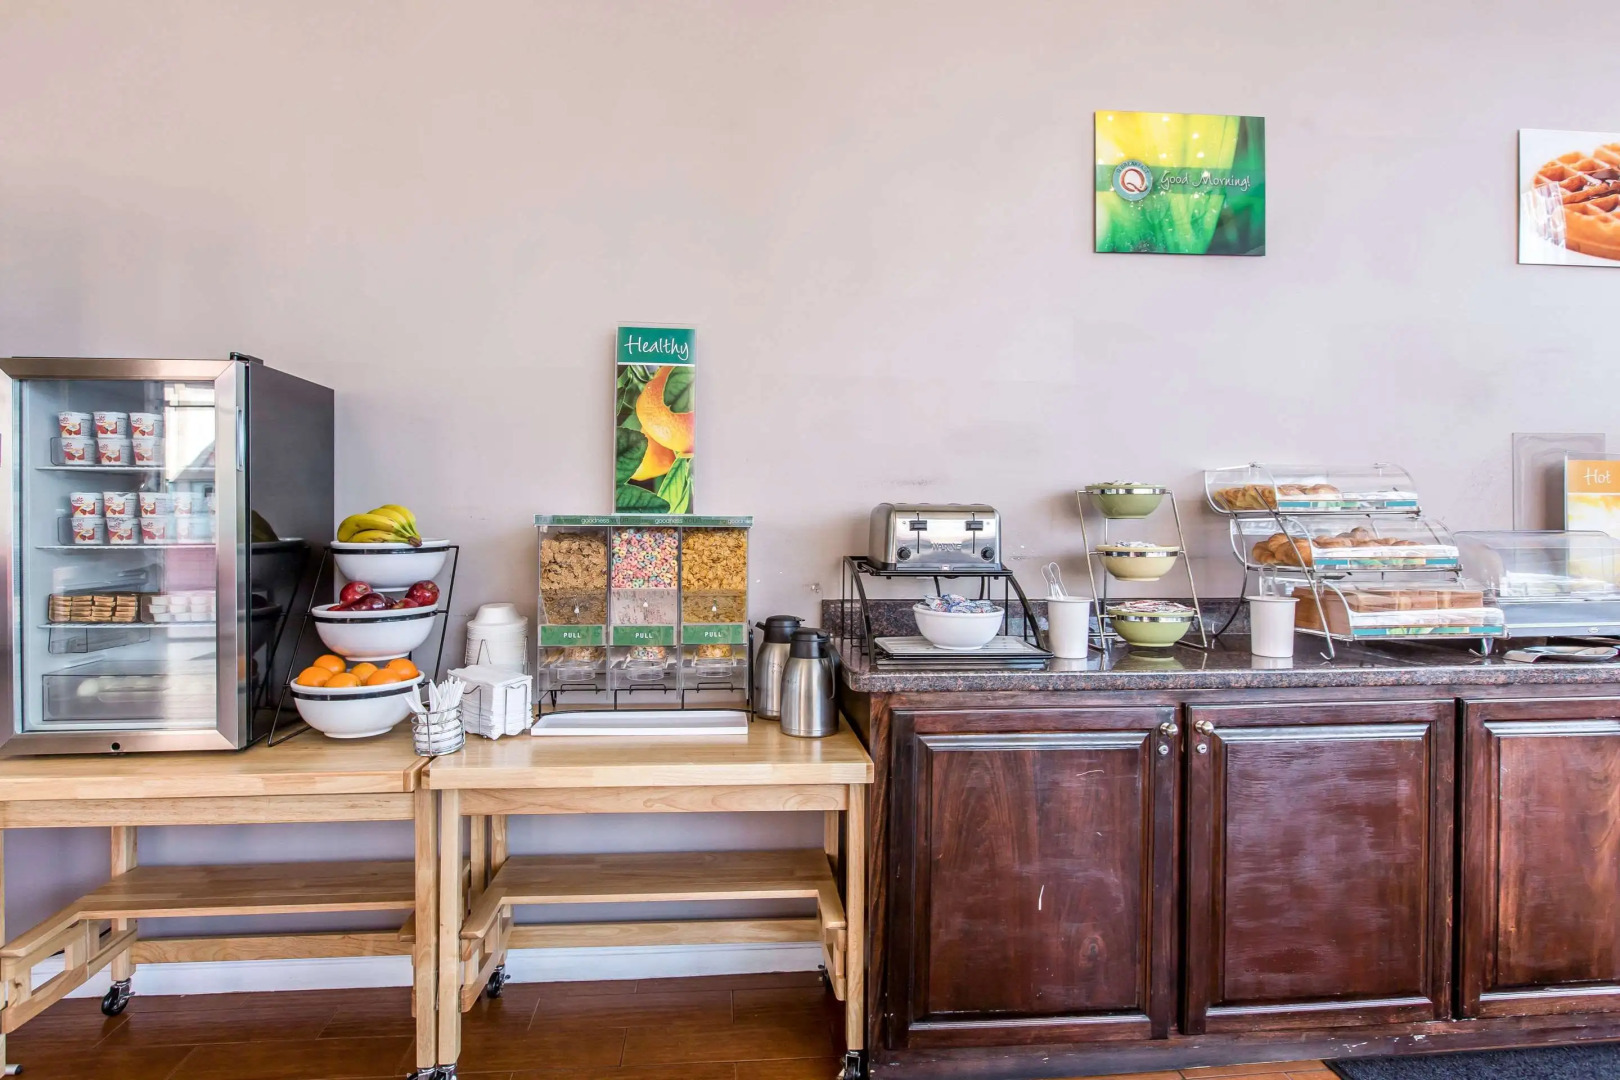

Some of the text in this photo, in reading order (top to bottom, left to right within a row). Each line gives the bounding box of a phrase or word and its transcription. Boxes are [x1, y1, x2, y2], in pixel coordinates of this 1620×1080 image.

[1120, 168, 1148, 192] Q
[1160, 170, 1251, 192] Good Morning!
[623, 334, 689, 361] Healthy
[1583, 466, 1611, 486] Hot
[581, 516, 610, 525] goodness
